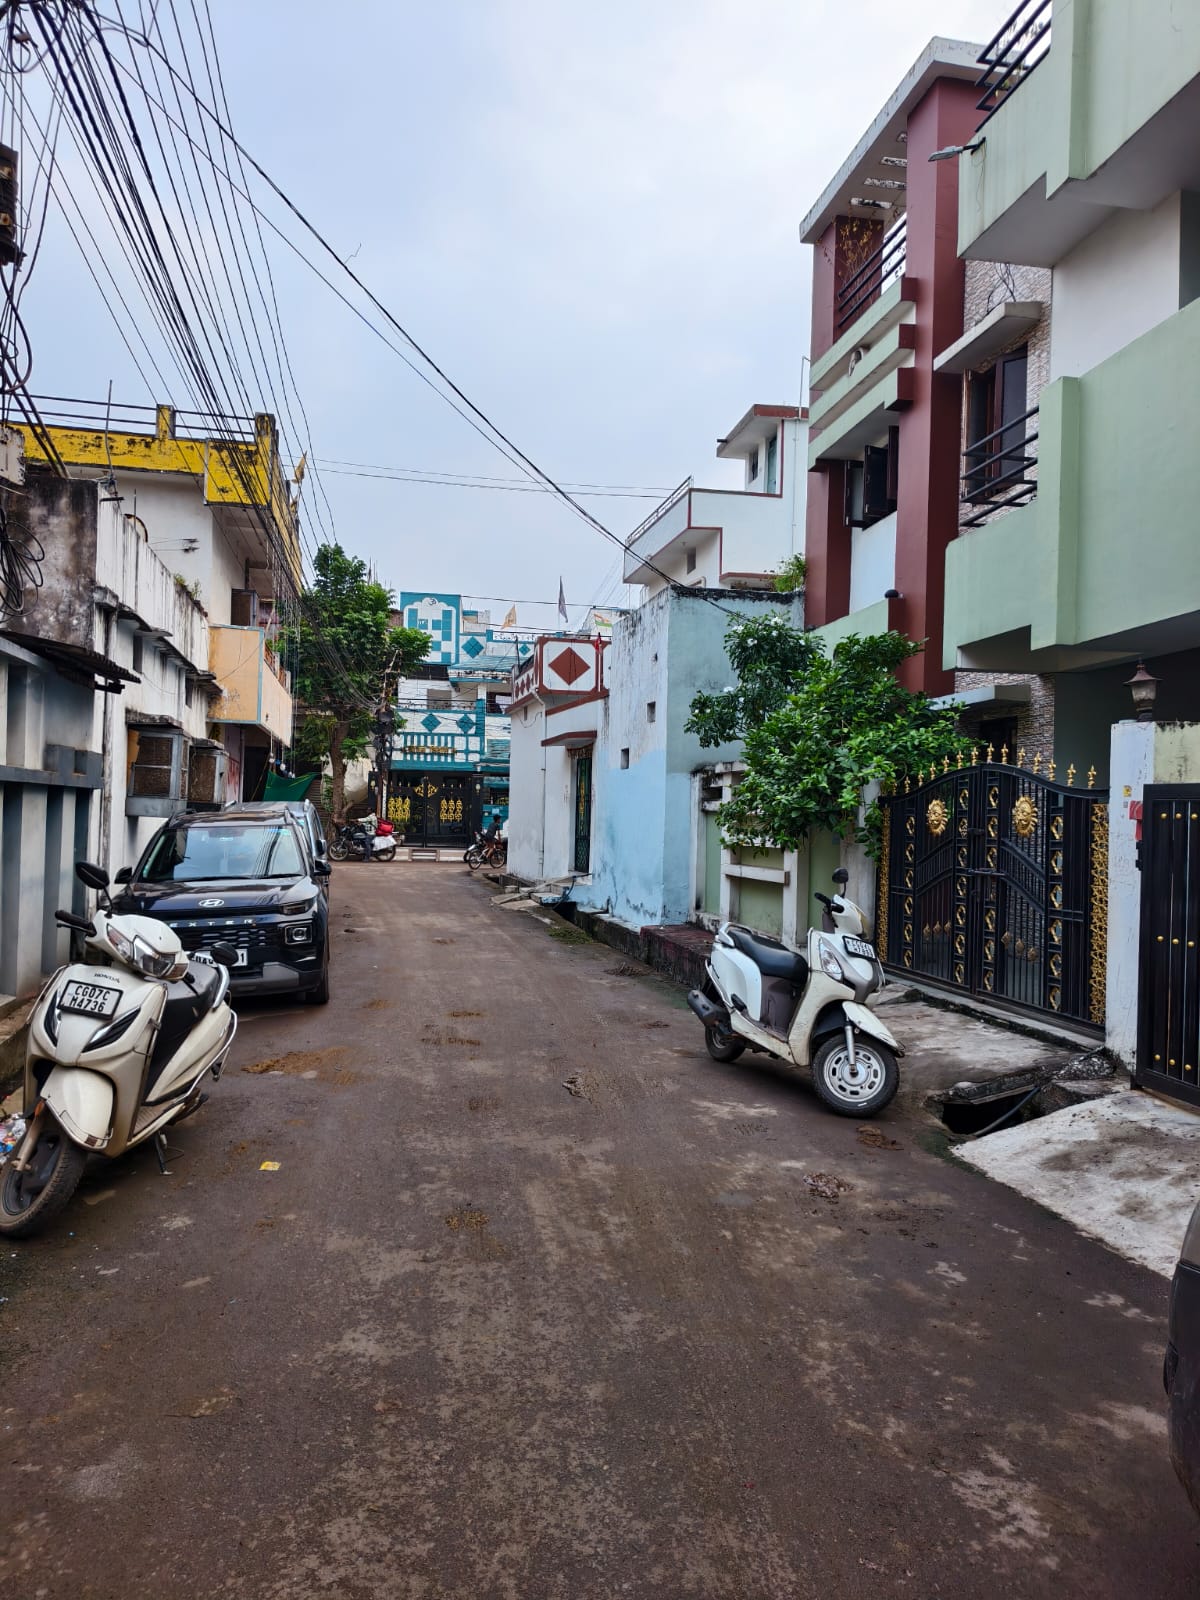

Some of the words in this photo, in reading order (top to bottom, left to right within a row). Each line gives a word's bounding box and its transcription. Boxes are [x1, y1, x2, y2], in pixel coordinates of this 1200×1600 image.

[169, 919, 253, 928] EXTER
[74, 985, 111, 1001] CG07C
[69, 996, 106, 1012] M4736
